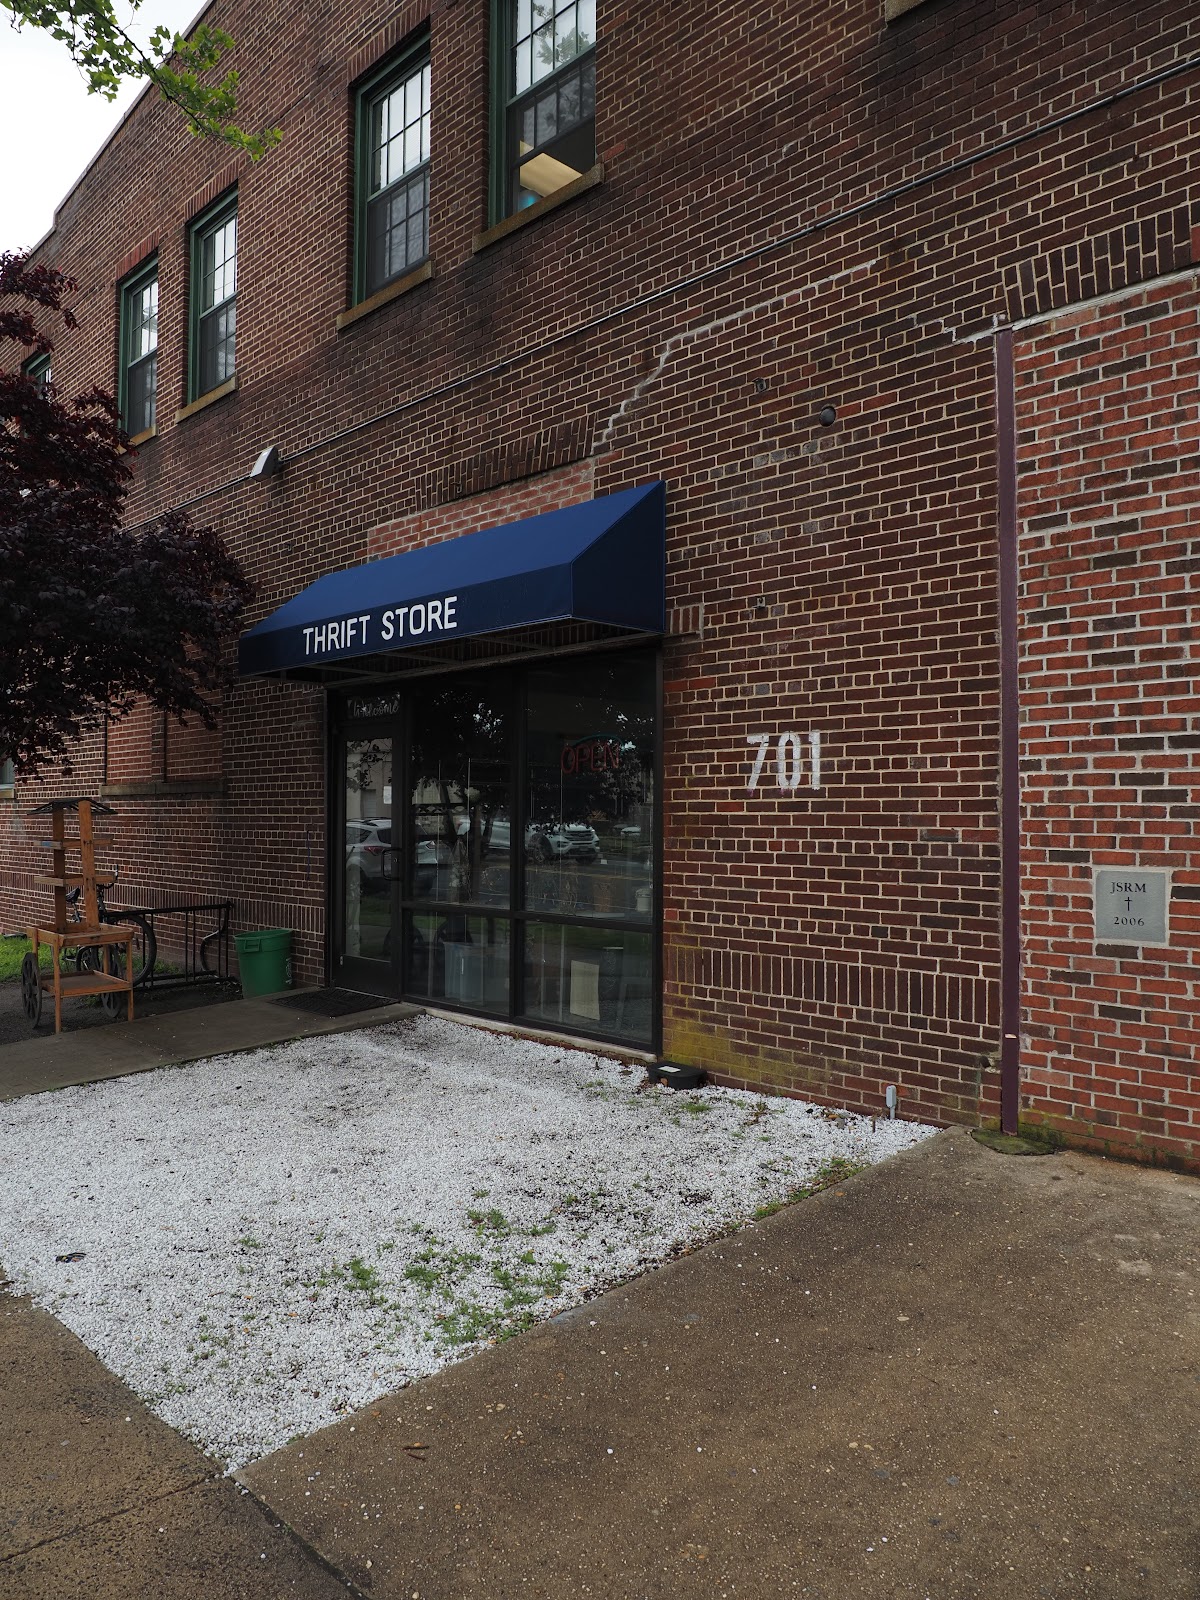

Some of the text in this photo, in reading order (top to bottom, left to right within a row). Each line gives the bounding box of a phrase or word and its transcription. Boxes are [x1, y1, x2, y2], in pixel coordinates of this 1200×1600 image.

[302, 595, 458, 655] THRIFT STORE
[561, 741, 619, 774] OPEN
[746, 729, 820, 790] 701
[1110, 881, 1147, 894] JSRM
[1114, 916, 1145, 927] 2006
